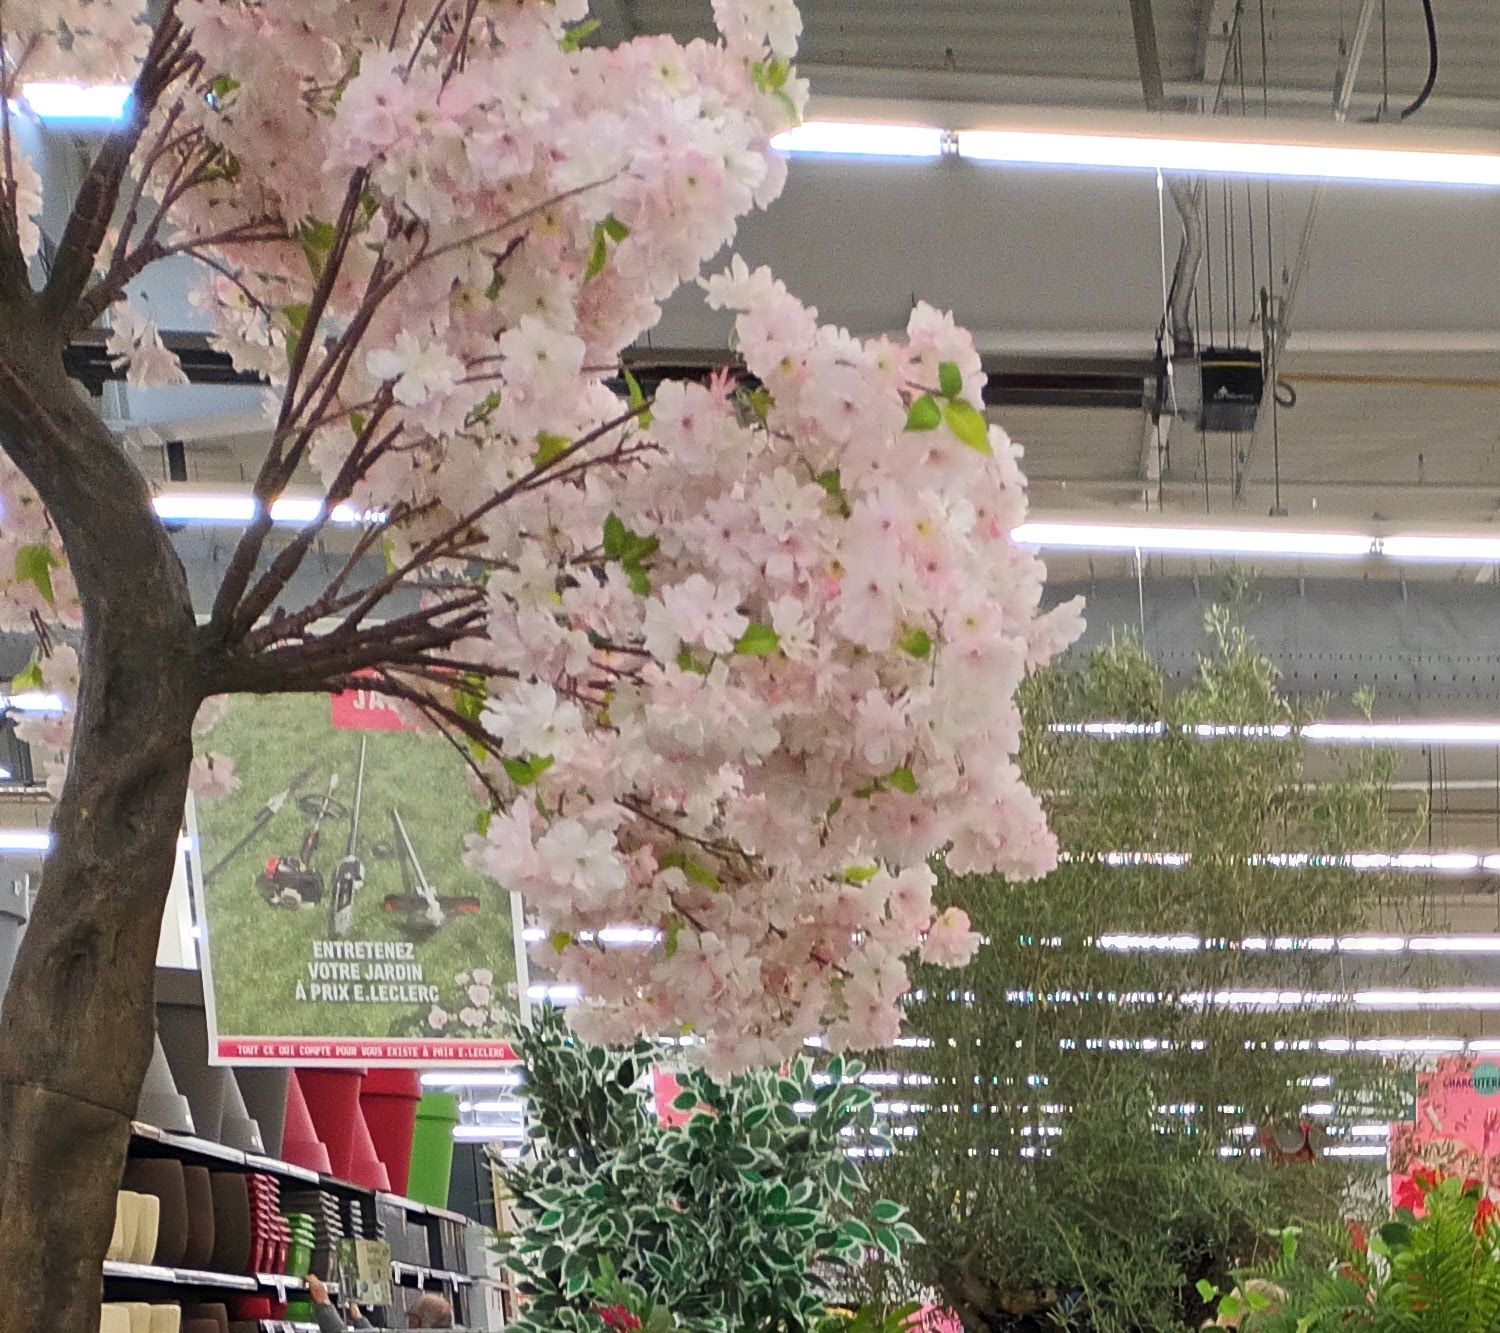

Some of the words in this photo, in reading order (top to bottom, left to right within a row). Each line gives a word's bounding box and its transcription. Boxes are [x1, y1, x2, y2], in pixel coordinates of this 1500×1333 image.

[313, 940, 414, 960] ENTRETENEZ
[308, 962, 361, 980] VOTRE
[365, 964, 423, 982] JARDIN
[295, 979, 307, 1000] À
[310, 983, 350, 1001] PRIX
[353, 984, 440, 1002] E.LECLERC
[237, 1044, 259, 1056] TOUT
[263, 1045, 275, 1056] CE
[300, 1045, 331, 1057] COMPTE
[336, 1046, 358, 1057] POUR
[361, 1046, 383, 1057] VOUS
[387, 1046, 418, 1058] EXISTE
[433, 1047, 454, 1058] PRIX
